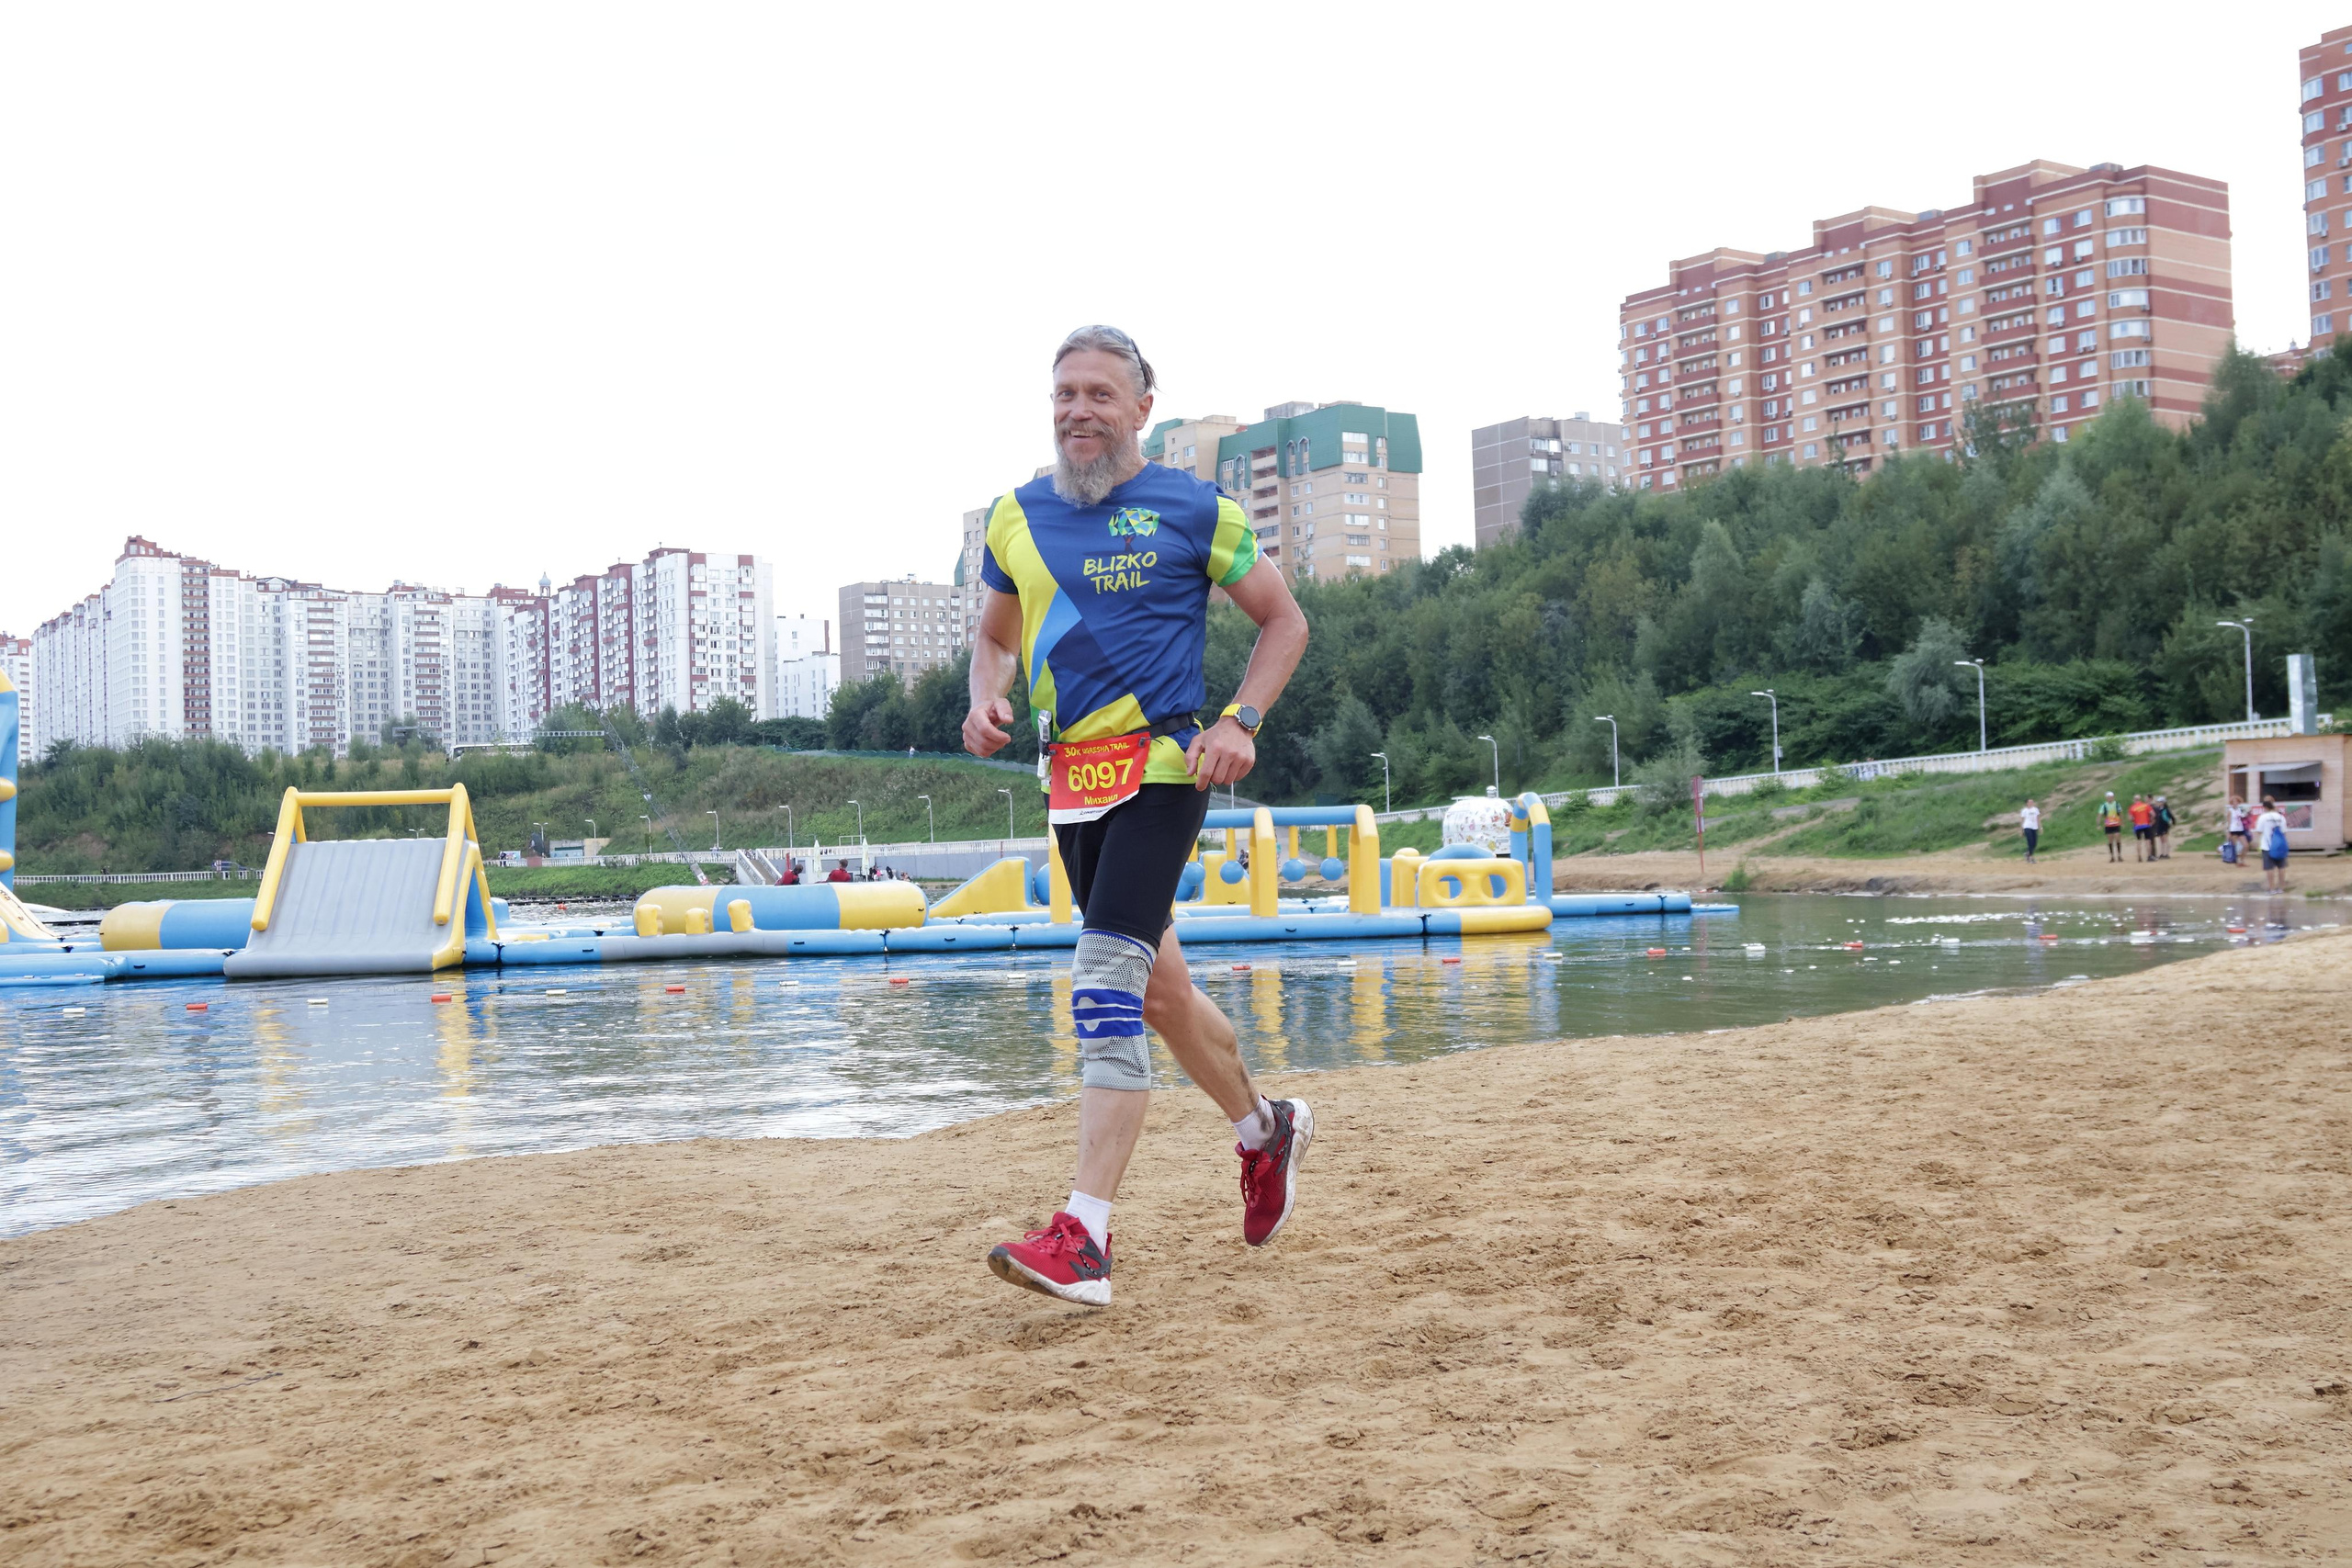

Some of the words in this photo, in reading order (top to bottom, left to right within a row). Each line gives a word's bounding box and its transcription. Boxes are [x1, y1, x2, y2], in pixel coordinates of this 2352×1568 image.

[1083, 551, 1158, 576] BLIZKO
[1091, 570, 1150, 594] TRAIL
[1082, 745, 1109, 754] UGRESHA
[1110, 742, 1130, 750] TRAIL
[1069, 758, 1133, 791] 6097
[1084, 794, 1118, 805] Михаил
